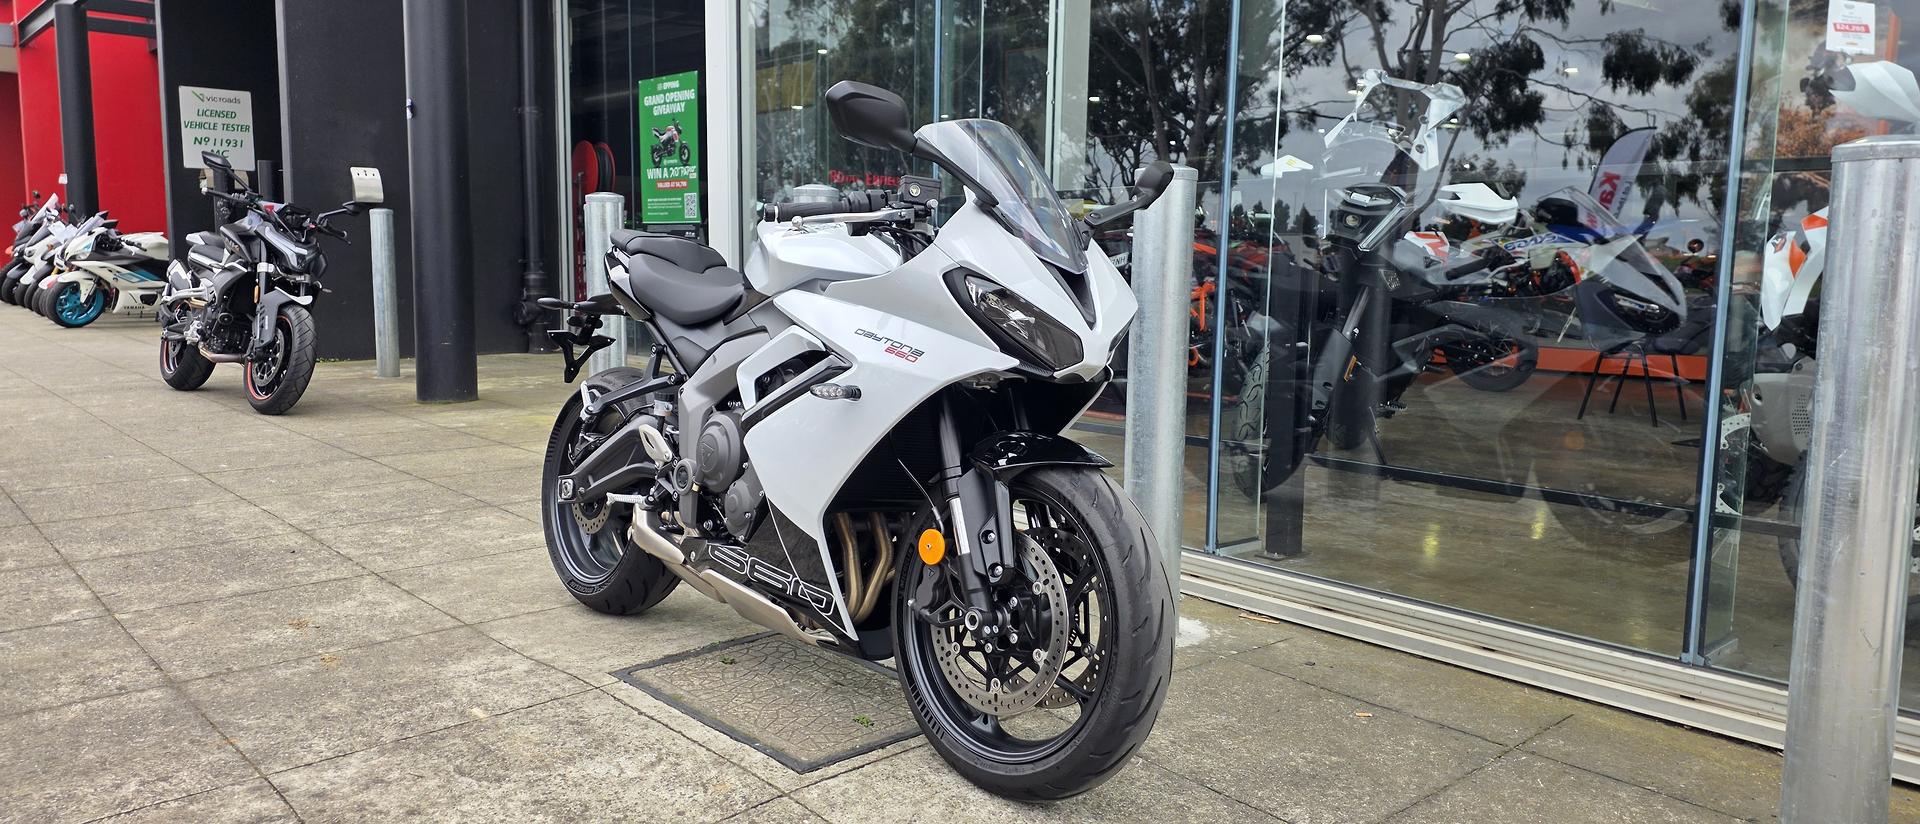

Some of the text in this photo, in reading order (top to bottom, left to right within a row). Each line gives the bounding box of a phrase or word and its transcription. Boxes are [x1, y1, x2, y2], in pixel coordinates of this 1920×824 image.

[644, 89, 695, 106] GRAND OPENING
[196, 108, 237, 119] LICENSED
[653, 102, 685, 115] GIVEAWAY
[183, 120, 251, 133] VEHICLE TESTER
[213, 138, 244, 148] 11931
[646, 167, 662, 180] WIN
[662, 167, 669, 179] A
[854, 328, 926, 358] DAYTONA
[884, 346, 919, 363] 660
[708, 544, 836, 616] 660
